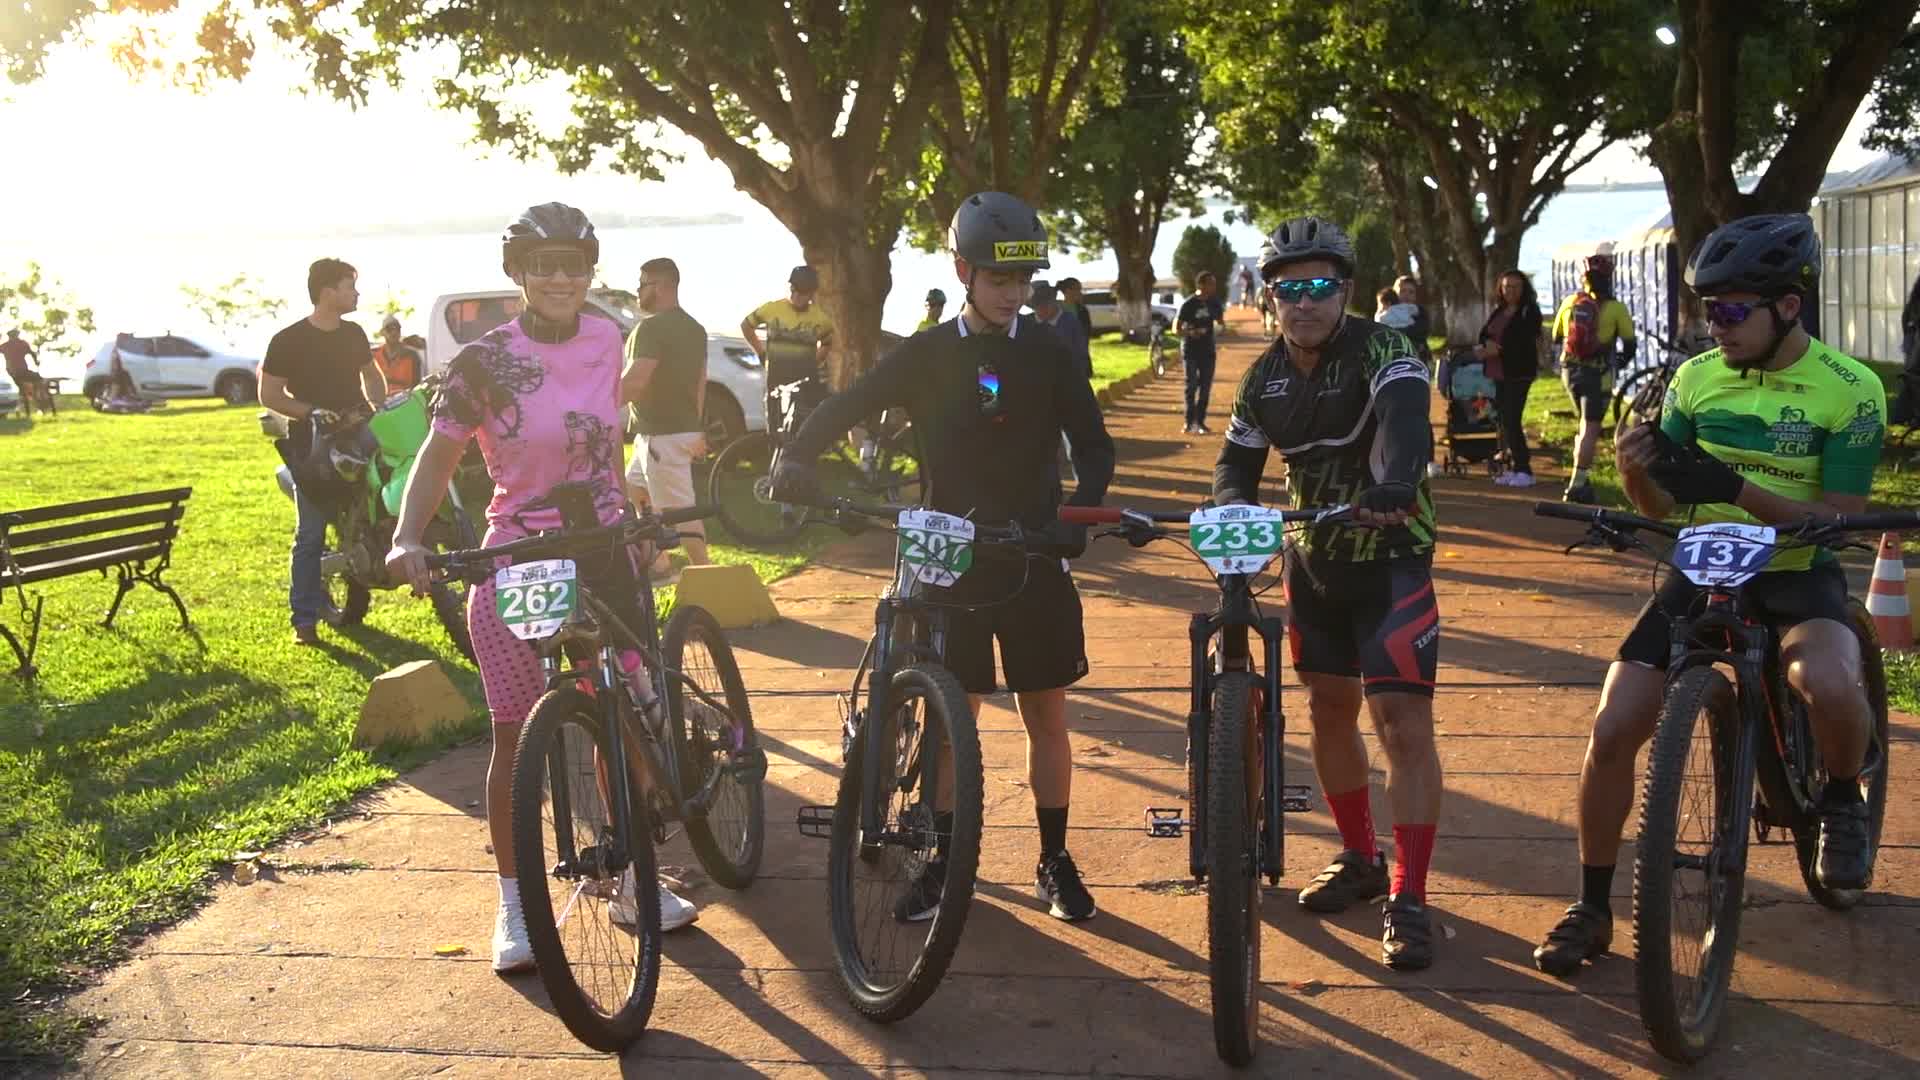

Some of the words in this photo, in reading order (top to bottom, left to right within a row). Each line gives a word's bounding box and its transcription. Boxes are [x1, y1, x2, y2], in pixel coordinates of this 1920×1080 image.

[1691, 351, 1722, 366] BLIND
[1819, 352, 1860, 386] BLINDEX
[1774, 440, 1808, 455] XCM
[1198, 521, 1276, 550] 233
[1684, 541, 1765, 567] 137
[502, 581, 569, 618] 262
